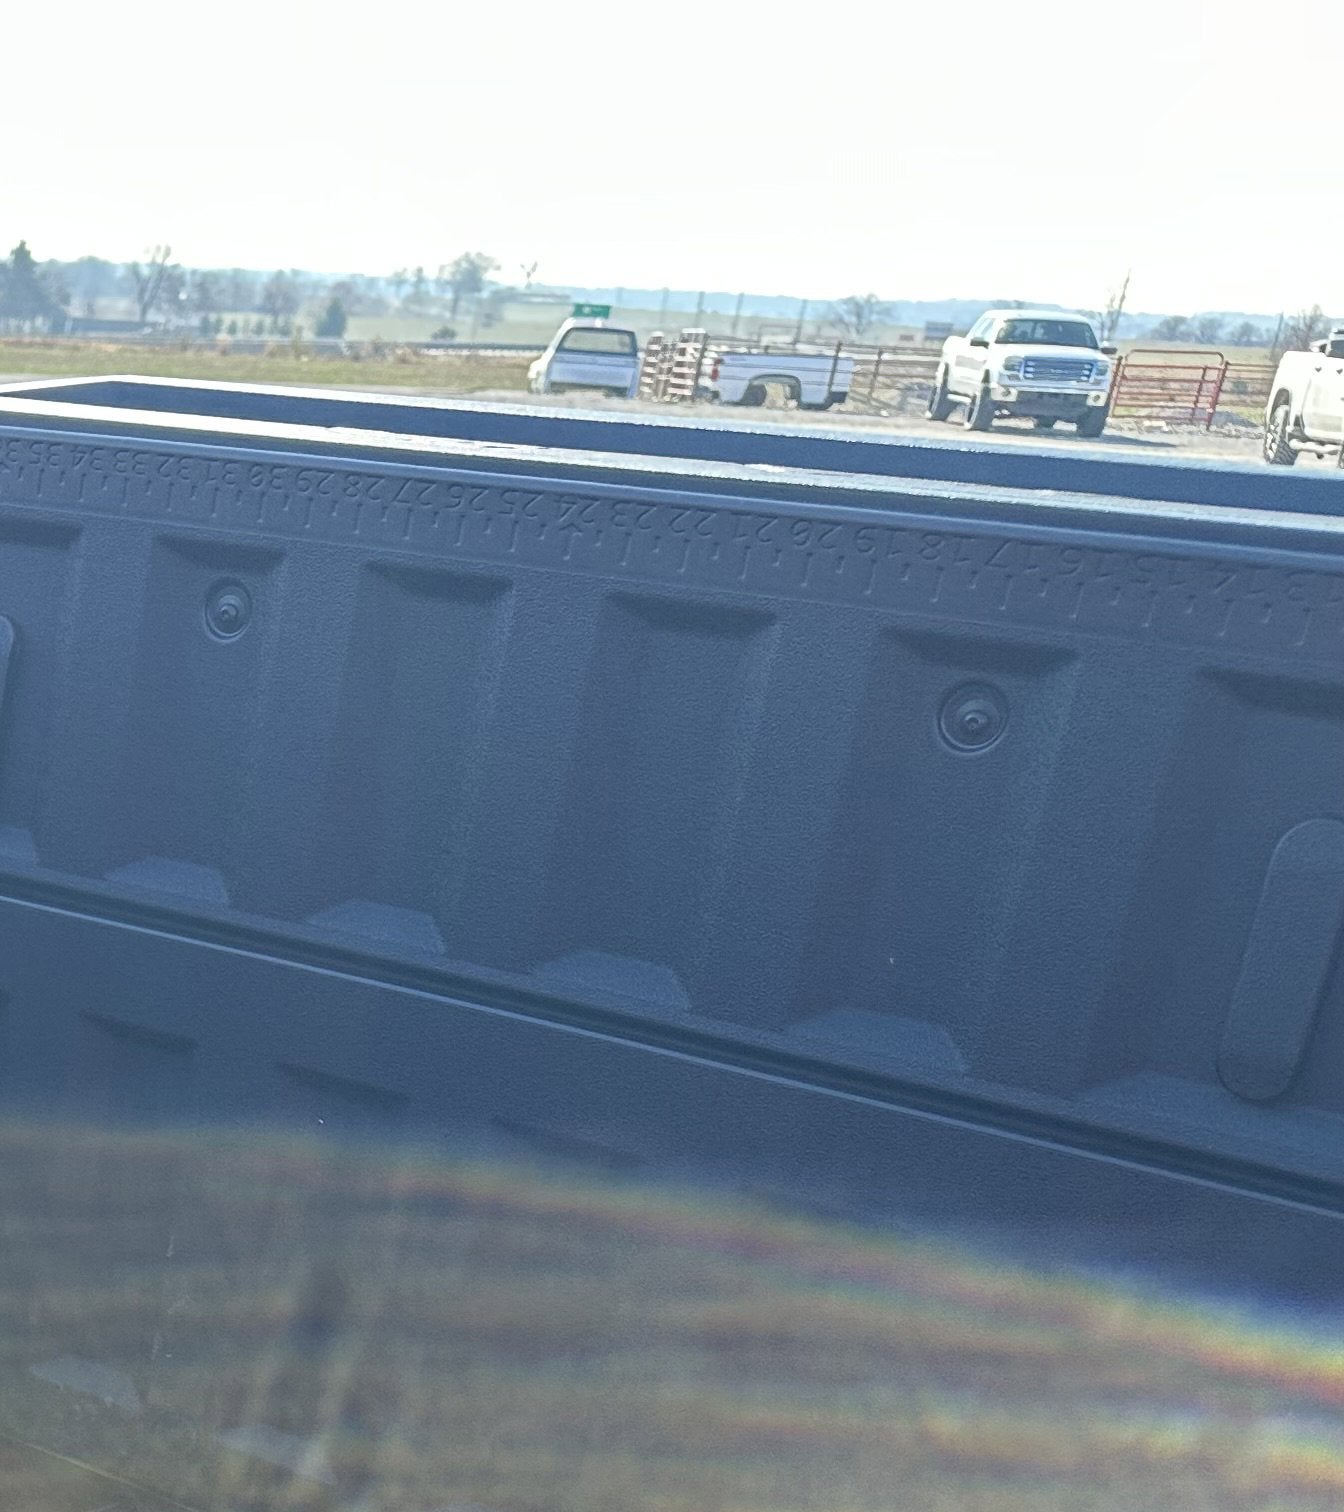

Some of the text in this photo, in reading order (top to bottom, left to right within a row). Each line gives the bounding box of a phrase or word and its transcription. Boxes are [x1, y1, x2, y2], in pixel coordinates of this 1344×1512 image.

[28, 442, 62, 468] 35
[70, 447, 104, 472] 34
[114, 450, 149, 478] 33
[157, 454, 196, 482] 32
[202, 459, 240, 487] 31
[295, 469, 334, 496] 29
[343, 474, 385, 501] 28
[392, 479, 436, 507] 27
[444, 484, 488, 513] 26
[498, 490, 544, 519] 25
[556, 496, 600, 524] 24
[612, 502, 656, 530] 23
[669, 507, 716, 539] 22
[732, 514, 778, 544] 21
[854, 527, 907, 558] 19
[920, 534, 976, 566] 18
[984, 540, 1044, 574] 17
[1056, 548, 1114, 581] 16
